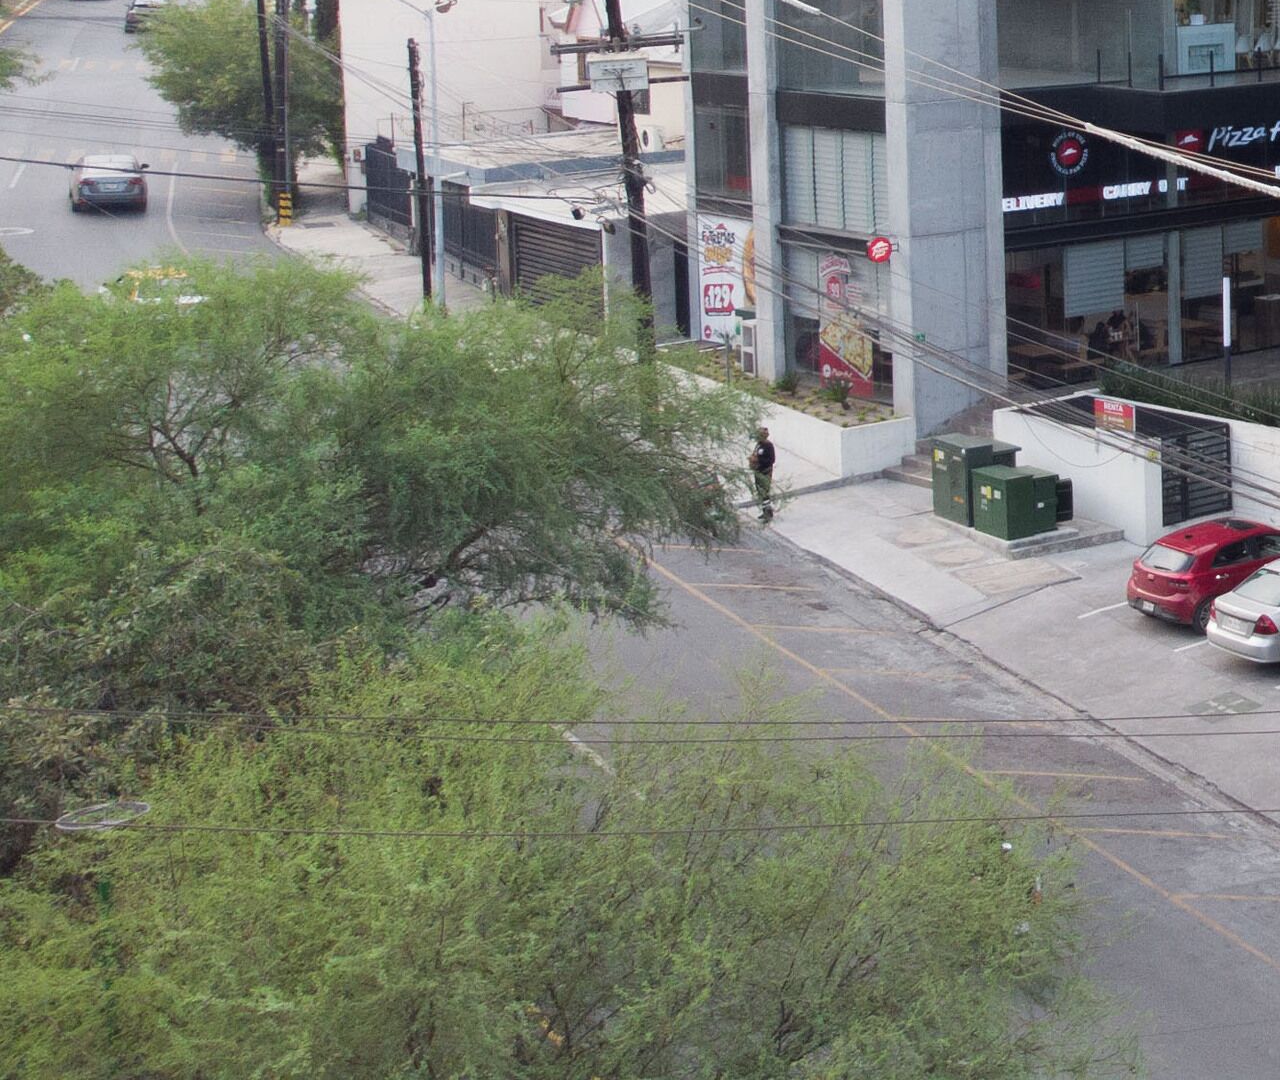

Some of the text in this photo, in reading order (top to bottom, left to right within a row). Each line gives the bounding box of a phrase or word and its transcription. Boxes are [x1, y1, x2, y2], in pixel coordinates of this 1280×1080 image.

[1208, 126, 1267, 152] Pizza
[1103, 180, 1152, 200] CARRY
[1002, 192, 1065, 212] ELIVERY
